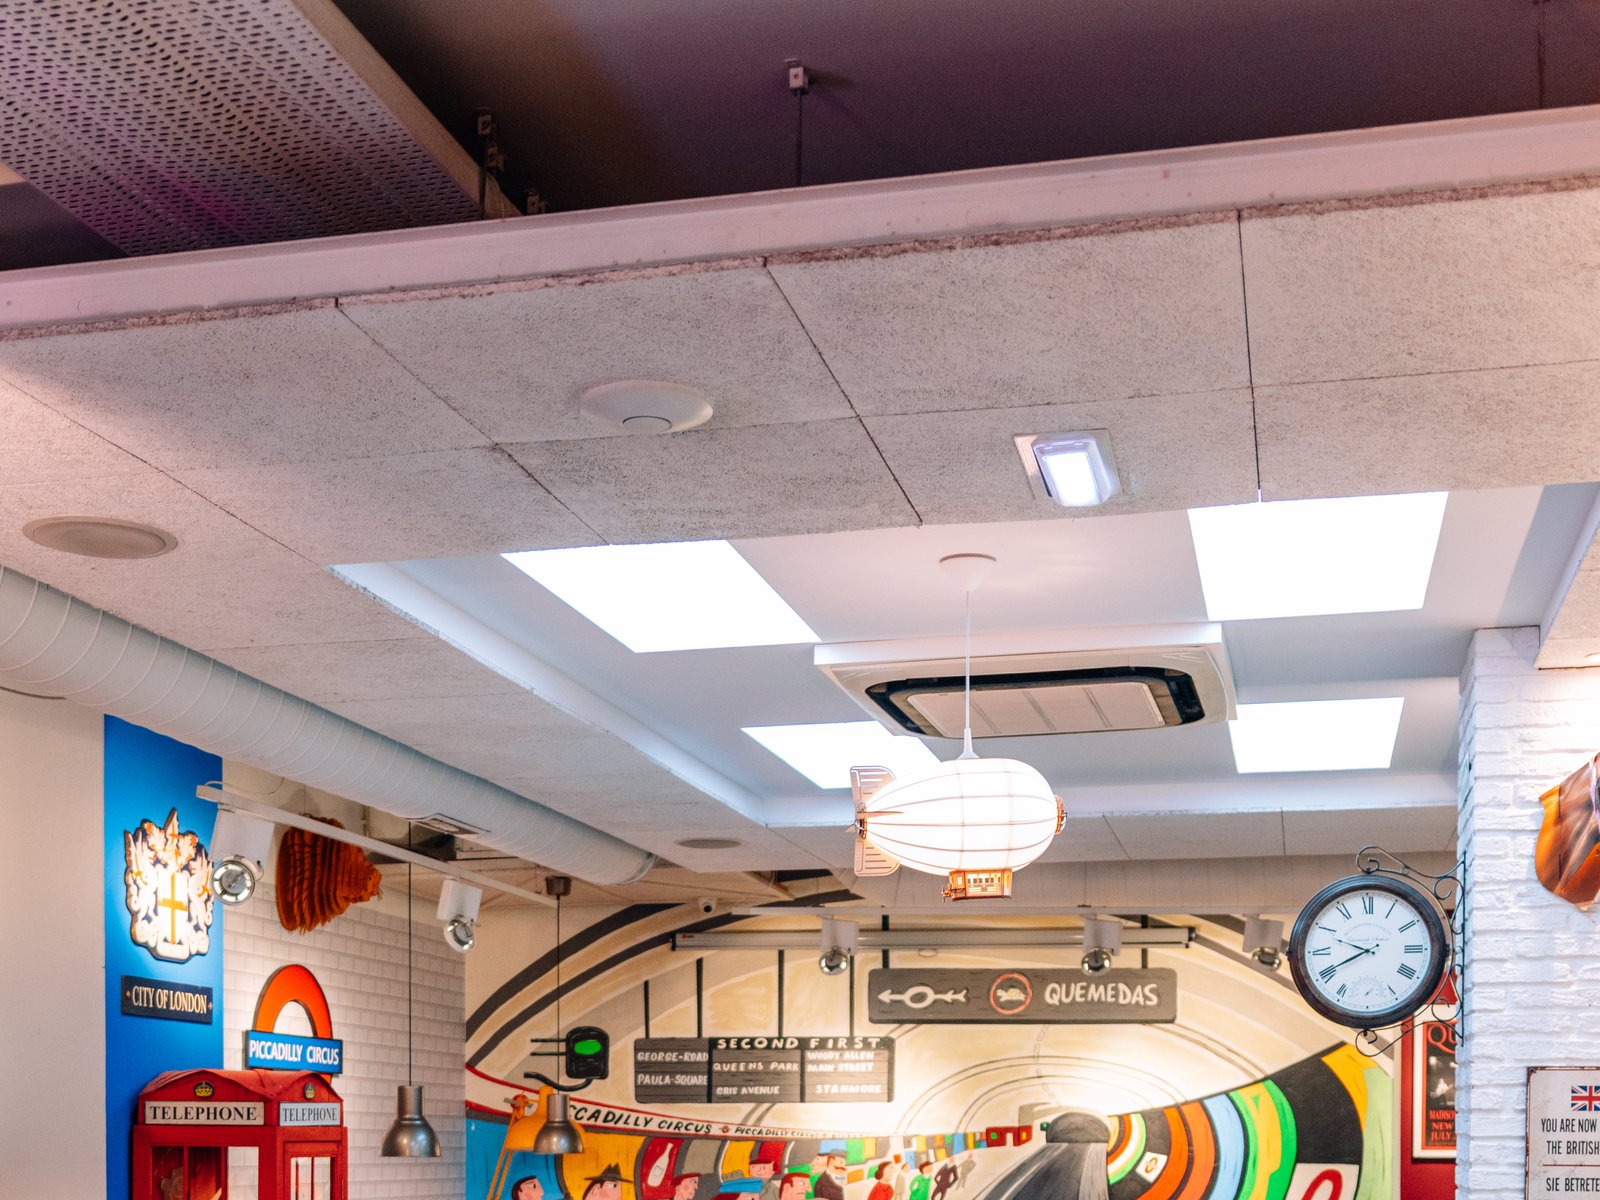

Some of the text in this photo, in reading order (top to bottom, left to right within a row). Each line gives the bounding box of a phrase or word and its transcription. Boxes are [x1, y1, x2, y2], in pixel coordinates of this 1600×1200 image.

[132, 985, 208, 1014] CITY OF LONDON
[1044, 982, 1159, 1006] QUEMEDAS
[717, 1038, 799, 1049] SECOND
[249, 1039, 339, 1066] PICCADILLY CIRCUS
[637, 1052, 709, 1061] GEORGE-ROAD
[843, 1051, 875, 1060] ALLEN
[713, 1062, 799, 1071] QUEENS PARK
[807, 1062, 874, 1072] MAIN STREET
[637, 1074, 709, 1085] PAULA-SQUARE
[741, 1086, 780, 1095] AVENUE
[815, 1084, 882, 1094] STANMORE
[150, 1105, 257, 1121] TELEPHONE
[282, 1107, 338, 1122] TELEPHONE
[658, 1119, 713, 1134] CIRCUS
[1432, 1122, 1454, 1130] NEW
[1541, 1118, 1597, 1133] YOU ARE NOW
[734, 1126, 788, 1137] PICCADILLY
[1431, 1131, 1451, 1141] JULY
[1546, 1140, 1600, 1155] THE BRITISH
[1546, 1178, 1560, 1192] SIE
